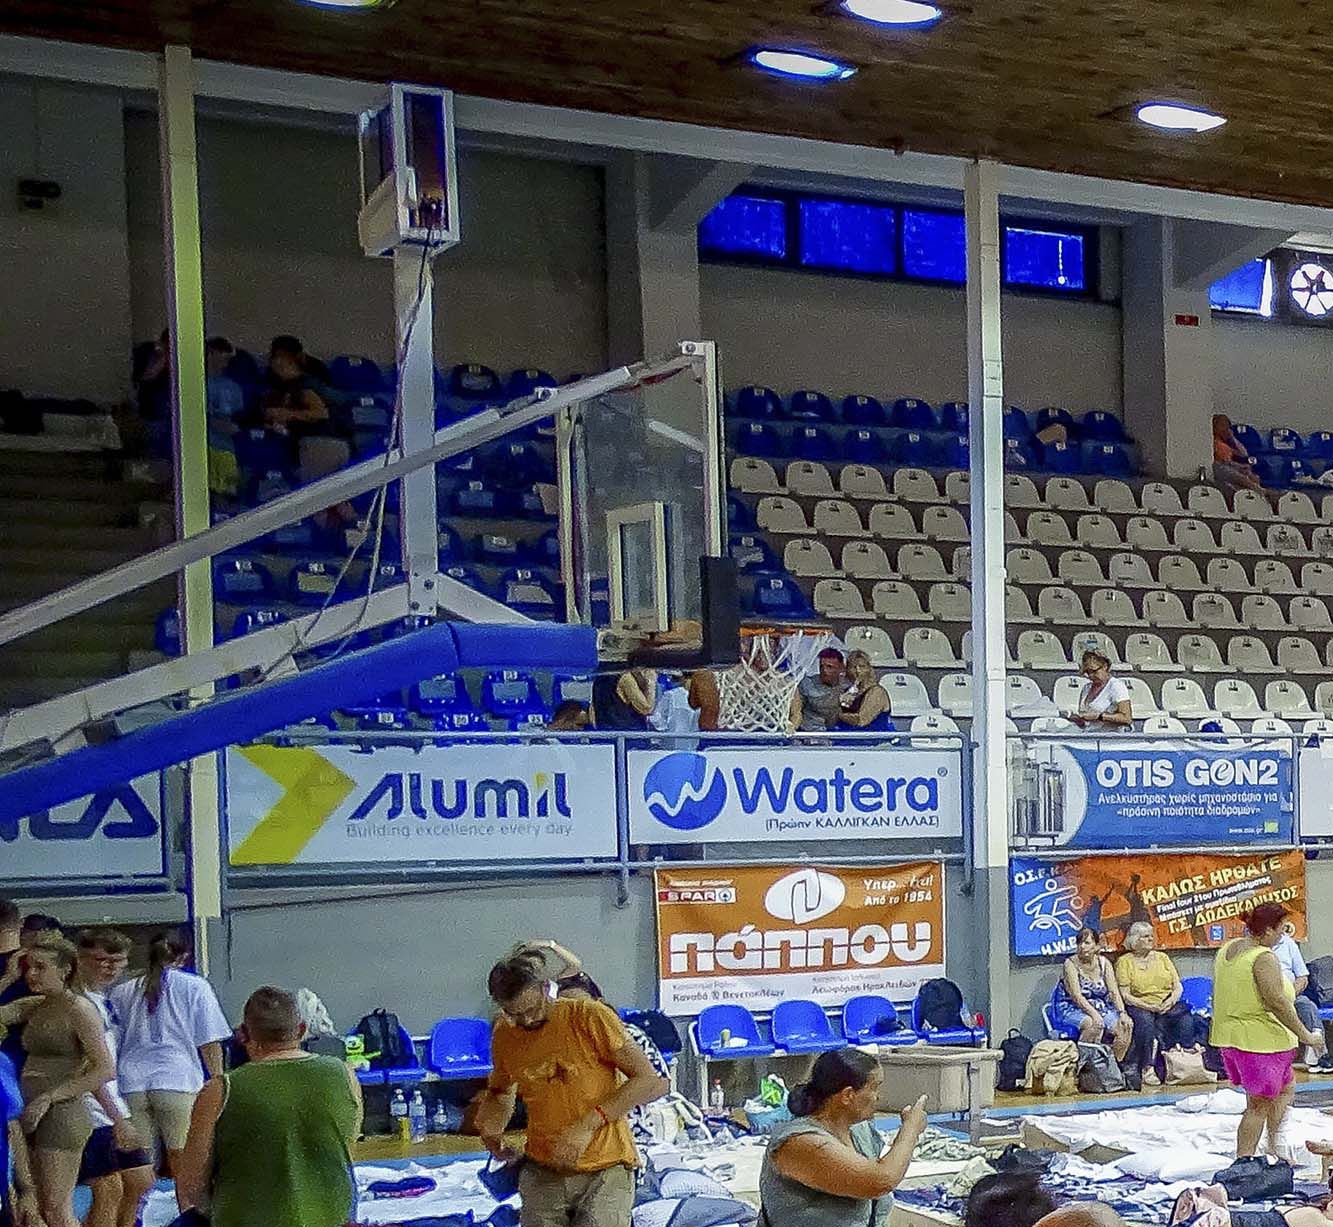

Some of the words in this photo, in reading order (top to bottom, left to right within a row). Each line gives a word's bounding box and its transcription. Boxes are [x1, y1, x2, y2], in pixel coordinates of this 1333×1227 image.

[1096, 759, 1175, 788] OTIS
[348, 772, 571, 820] Alumil
[732, 766, 939, 815] Watera
[1168, 791, 1196, 805] χωρίς
[346, 823, 410, 838] Building
[416, 823, 495, 836] excellence
[500, 825, 541, 838] every
[545, 823, 573, 838] day
[1141, 874, 1206, 905] ΚΑΛΩΣ
[1210, 855, 1283, 886] ΗΡΘΑΤΕ
[667, 890, 716, 902] SPAR
[1156, 900, 1177, 913] Final
[1168, 916, 1193, 935] Γ.Σ.
